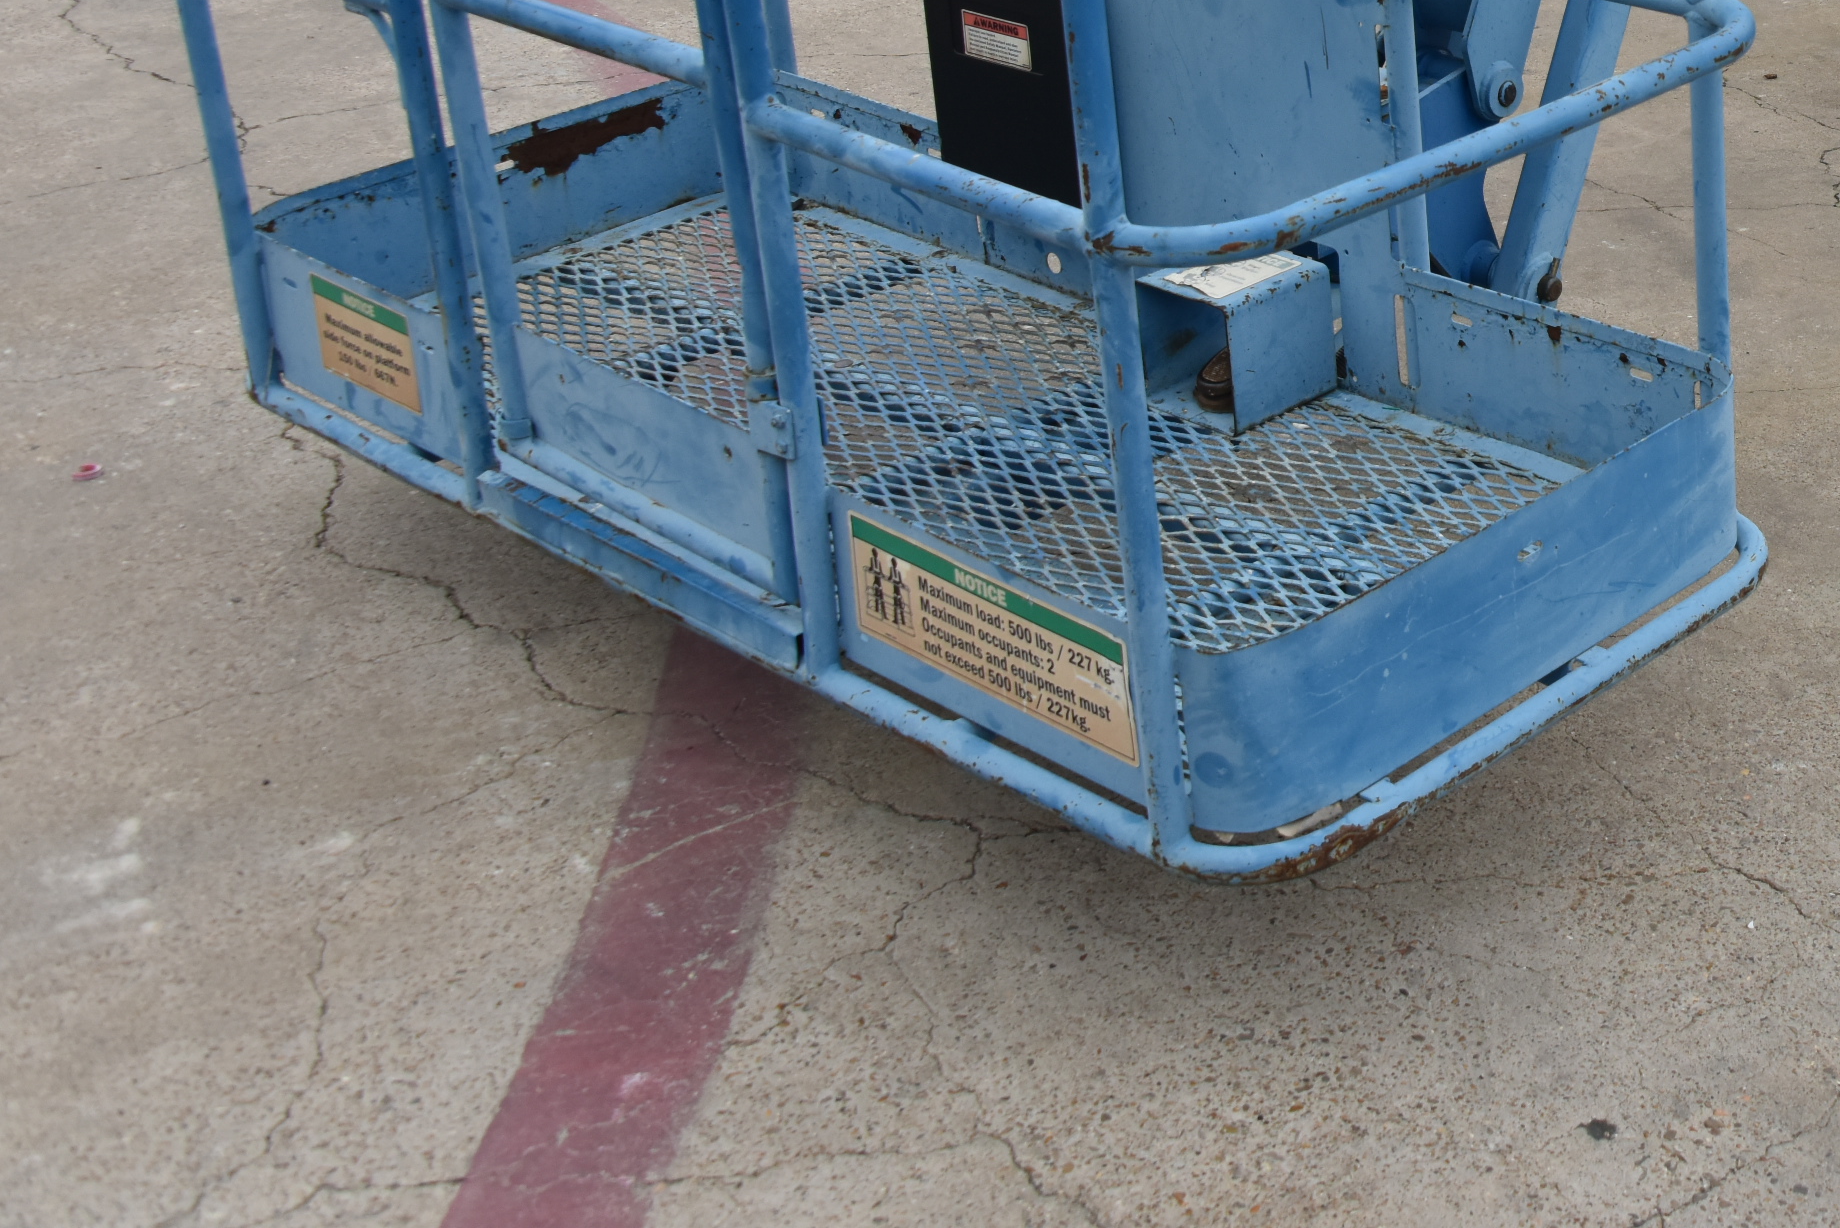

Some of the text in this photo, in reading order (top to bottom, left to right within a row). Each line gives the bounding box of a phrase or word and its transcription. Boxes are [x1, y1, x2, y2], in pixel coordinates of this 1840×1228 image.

[980, 19, 1018, 36] WARNING
[342, 292, 376, 318] NOTICE
[325, 312, 403, 357] Maximum allowable
[341, 336, 362, 354] force
[363, 349, 374, 360] on
[375, 354, 411, 376] platform
[954, 568, 1008, 607] NOTICE
[918, 575, 1115, 685] Maximum load: 500 lbs / 227 kg.
[919, 596, 1056, 675] Maximum occupants: 2
[922, 617, 1111, 722] Occupants and equipment must
[924, 639, 1091, 734] not exceed 500 lbs / 227kg.
